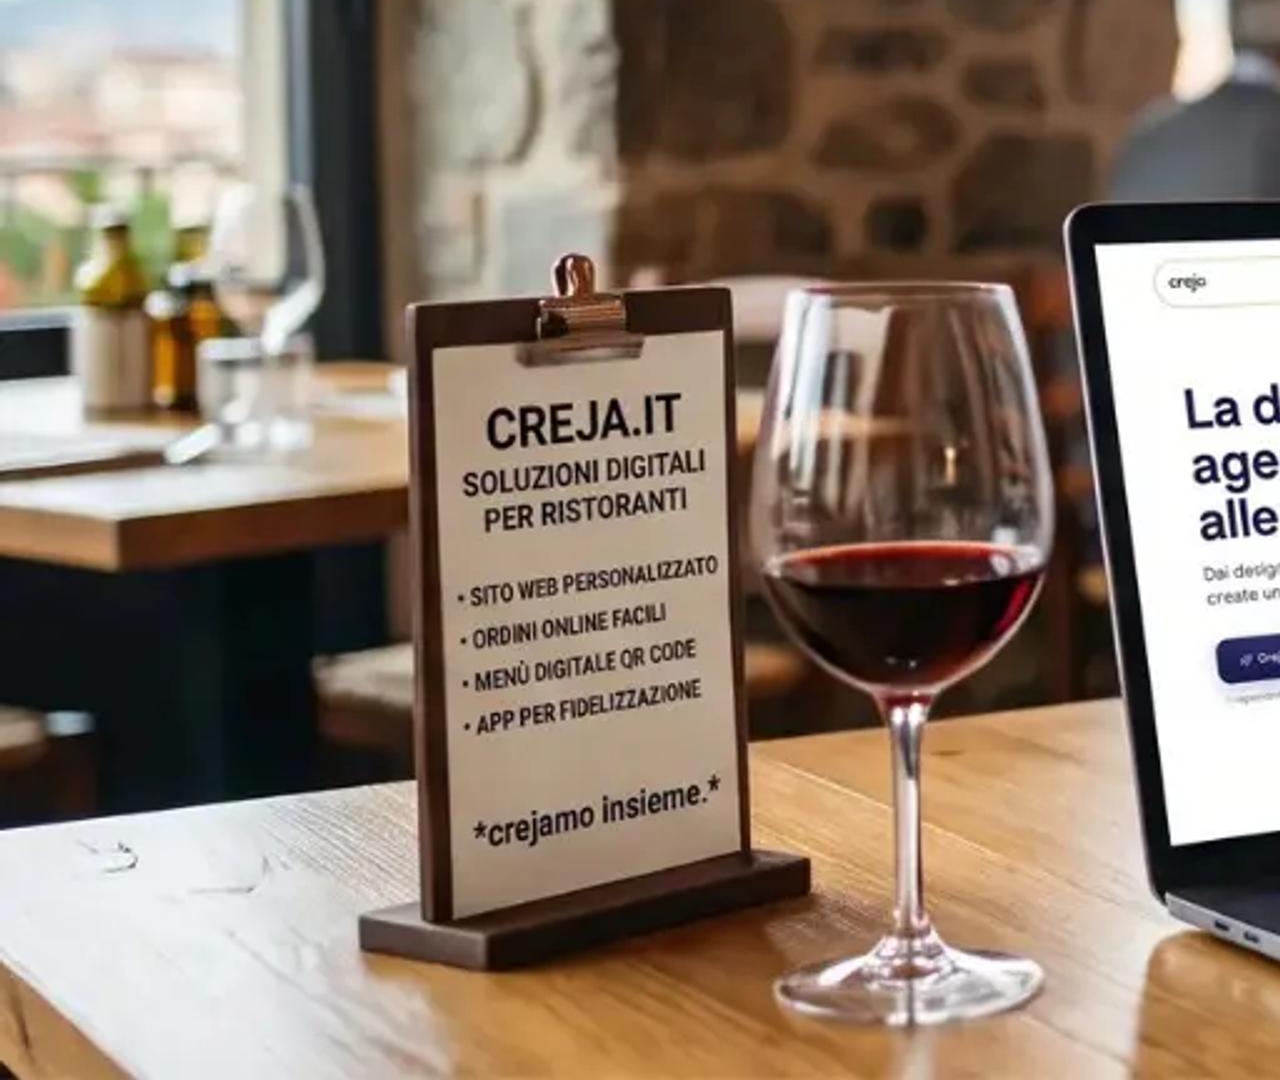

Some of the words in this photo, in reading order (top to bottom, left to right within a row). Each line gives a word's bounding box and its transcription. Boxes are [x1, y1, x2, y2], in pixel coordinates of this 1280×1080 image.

[487, 393, 681, 450] CREJA.IT
[1184, 388, 1241, 429] La
[463, 460, 598, 497] SOLUZIONI
[607, 449, 705, 481] DIGITALI
[485, 504, 533, 532] PER
[541, 487, 686, 526] RISTORANTI
[1200, 498, 1278, 541] alle
[470, 583, 513, 607] SITO
[518, 577, 558, 600] WEB
[563, 555, 718, 594] PERSONALIZZATO
[1207, 589, 1258, 606] create
[473, 621, 537, 649] ORDINI
[541, 611, 608, 638] ONLINE
[612, 603, 666, 628] FACILI
[475, 660, 530, 691] MENÙ
[535, 651, 615, 682] DIGITALE
[620, 647, 645, 670] QR
[650, 638, 696, 663] CODE
[477, 710, 515, 735] APP
[520, 703, 556, 727] PER
[560, 678, 701, 720] FIDELIZZAZIONE
